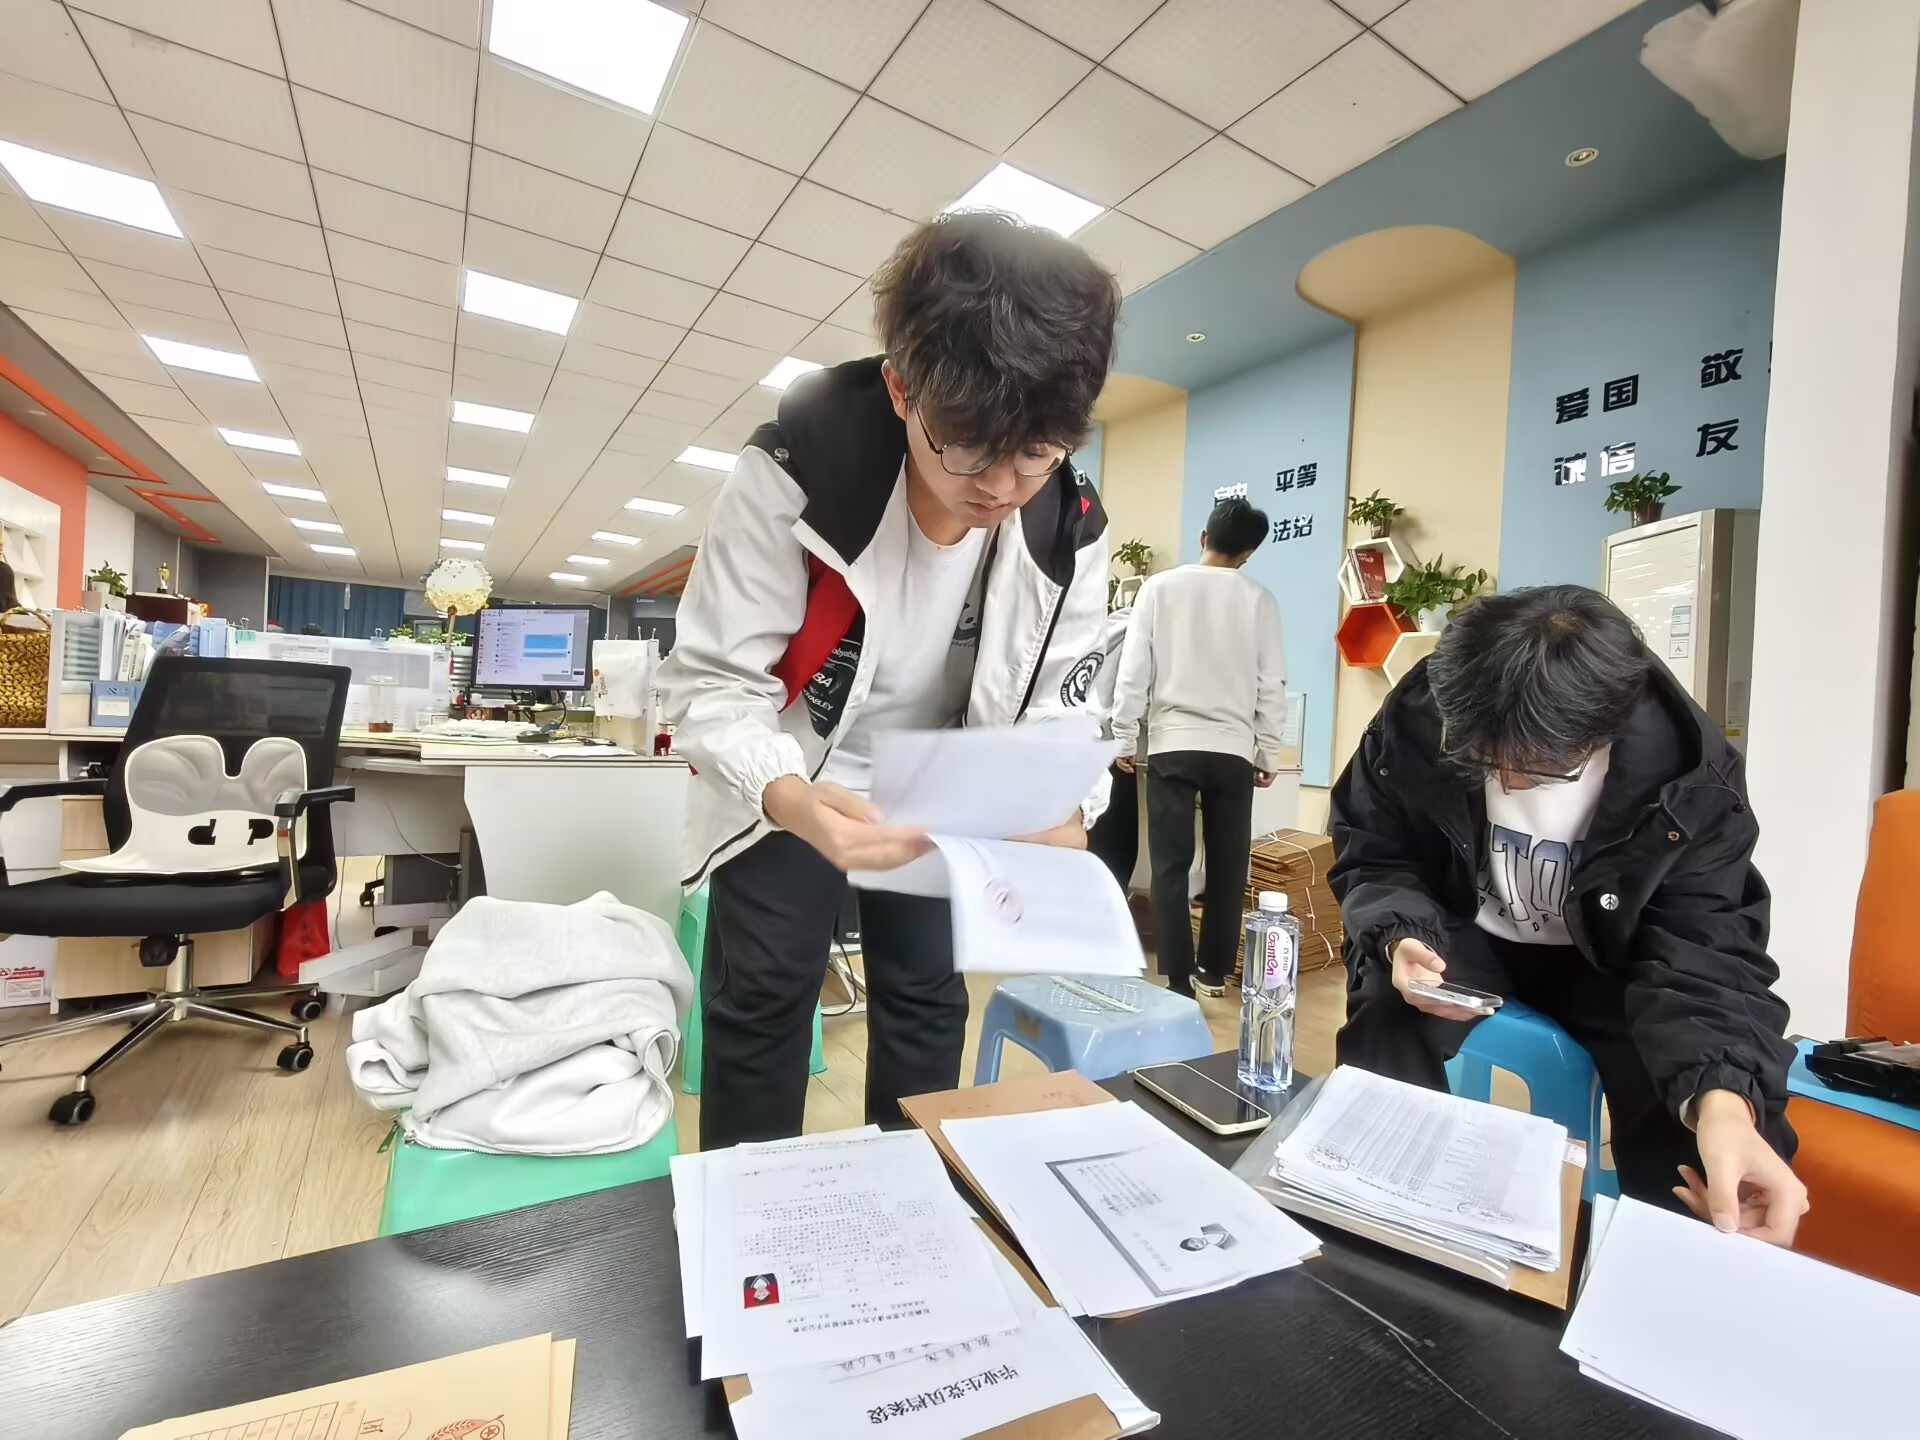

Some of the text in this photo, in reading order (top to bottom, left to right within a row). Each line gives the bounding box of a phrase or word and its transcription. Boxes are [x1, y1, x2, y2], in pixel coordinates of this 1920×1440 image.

[1555, 373, 1639, 425] 爱国
[1275, 462, 1318, 493] 平等
[1553, 418, 1739, 486] 诚信 友
[1271, 513, 1314, 544] 法治
[1477, 822, 1584, 921] TO
[866, 1364, 1020, 1426] 毕业生党员档案袋
